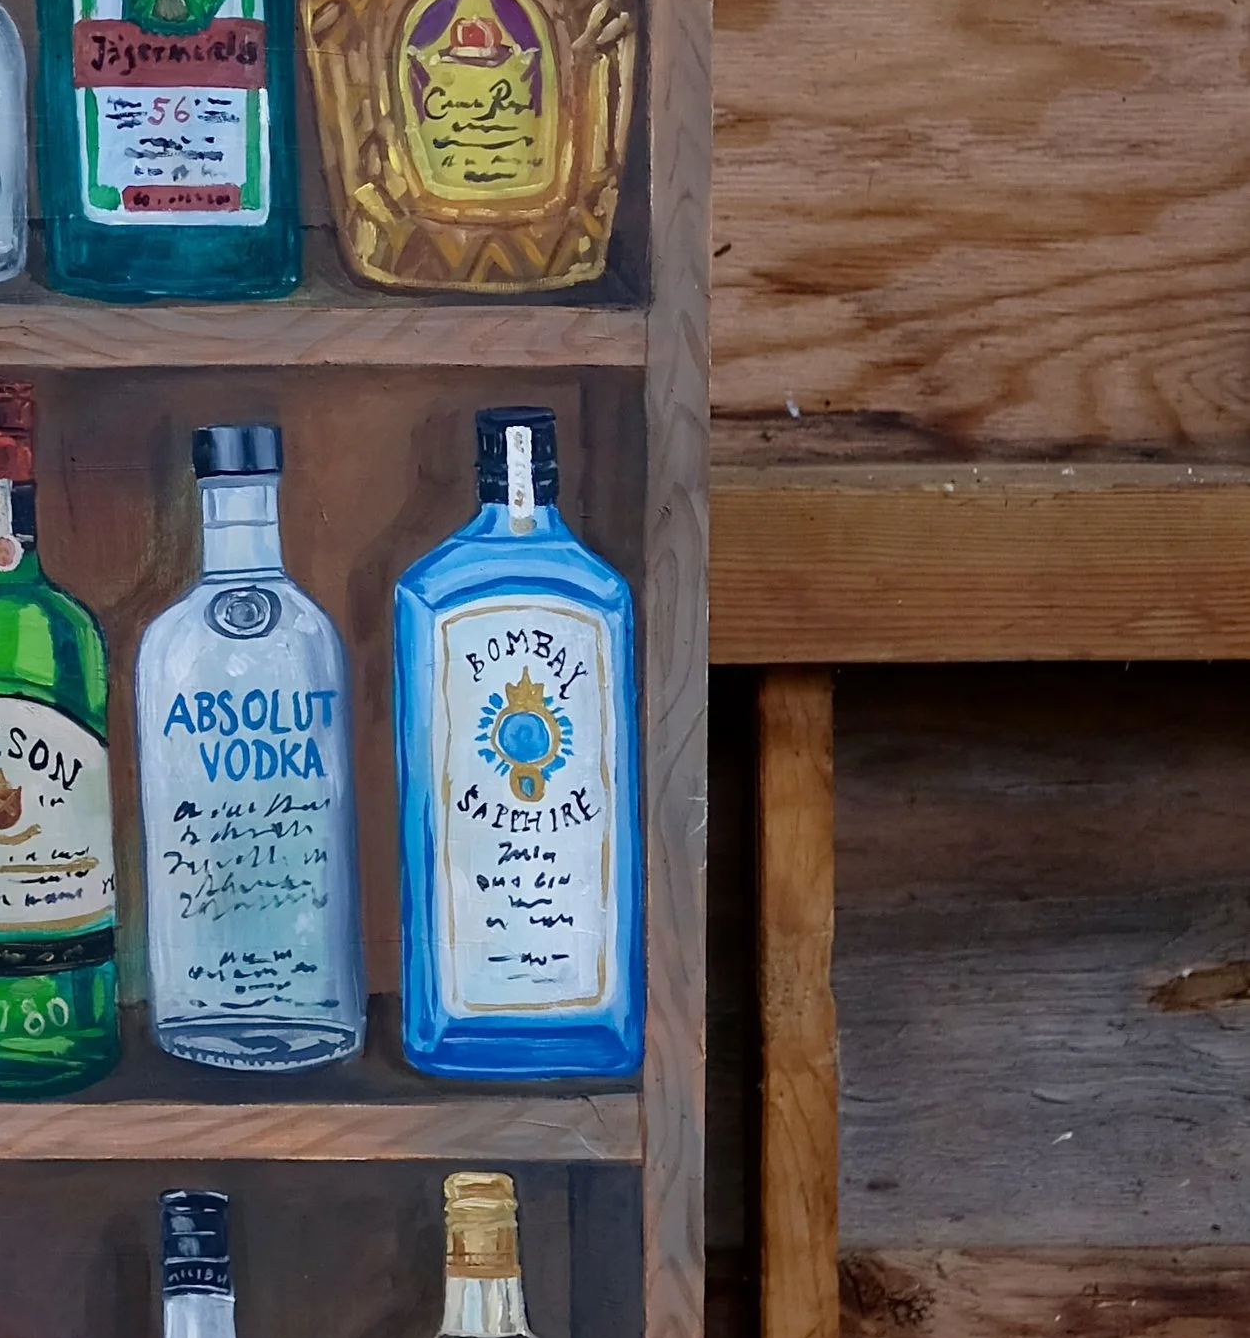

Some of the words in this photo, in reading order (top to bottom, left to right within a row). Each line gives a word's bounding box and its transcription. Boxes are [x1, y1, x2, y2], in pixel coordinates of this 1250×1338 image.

[147, 96, 191, 126] 56
[465, 627, 588, 700] BOMBAY
[163, 688, 338, 737] ABSOLUT
[199, 737, 327, 783] VODKA
